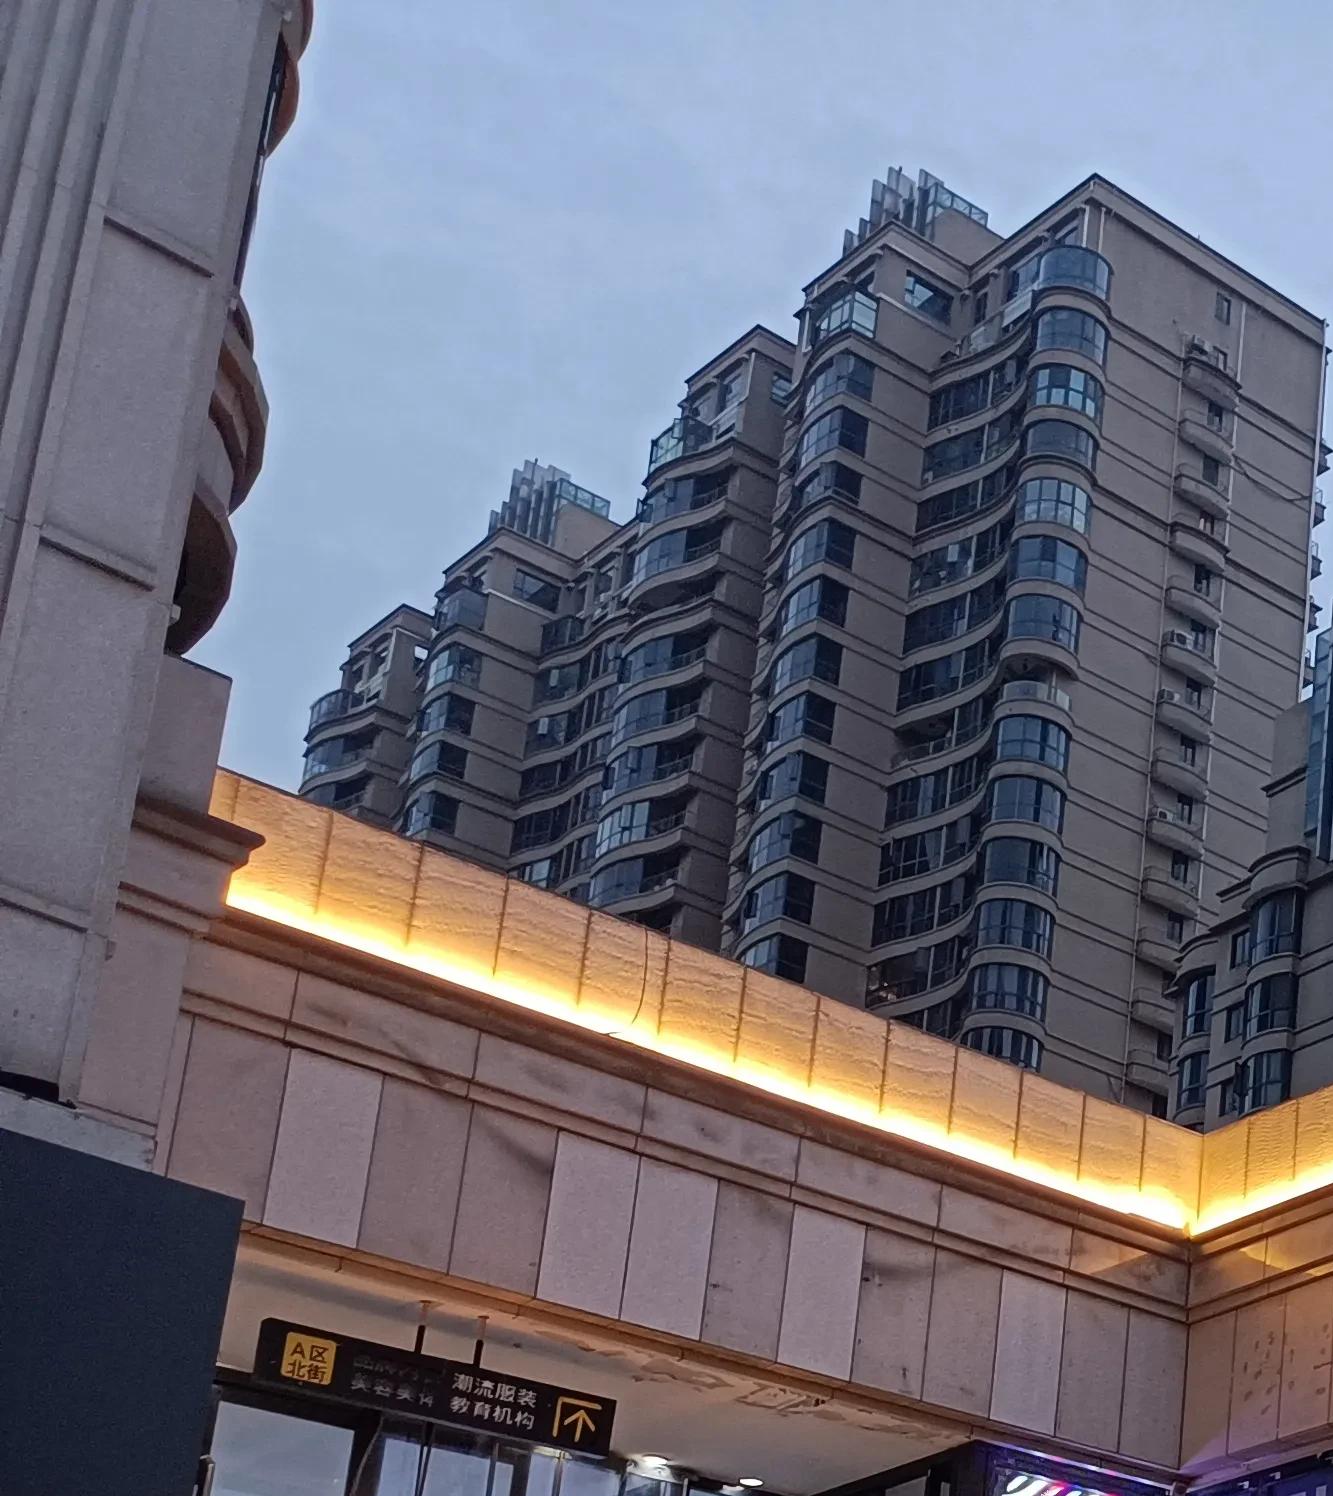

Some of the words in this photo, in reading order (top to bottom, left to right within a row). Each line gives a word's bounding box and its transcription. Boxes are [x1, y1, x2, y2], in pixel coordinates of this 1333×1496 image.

[290, 1342, 329, 1364] A区
[287, 1360, 328, 1384] 北街
[452, 1372, 538, 1409] 潮流服装
[450, 1396, 536, 1431] 教育机构
